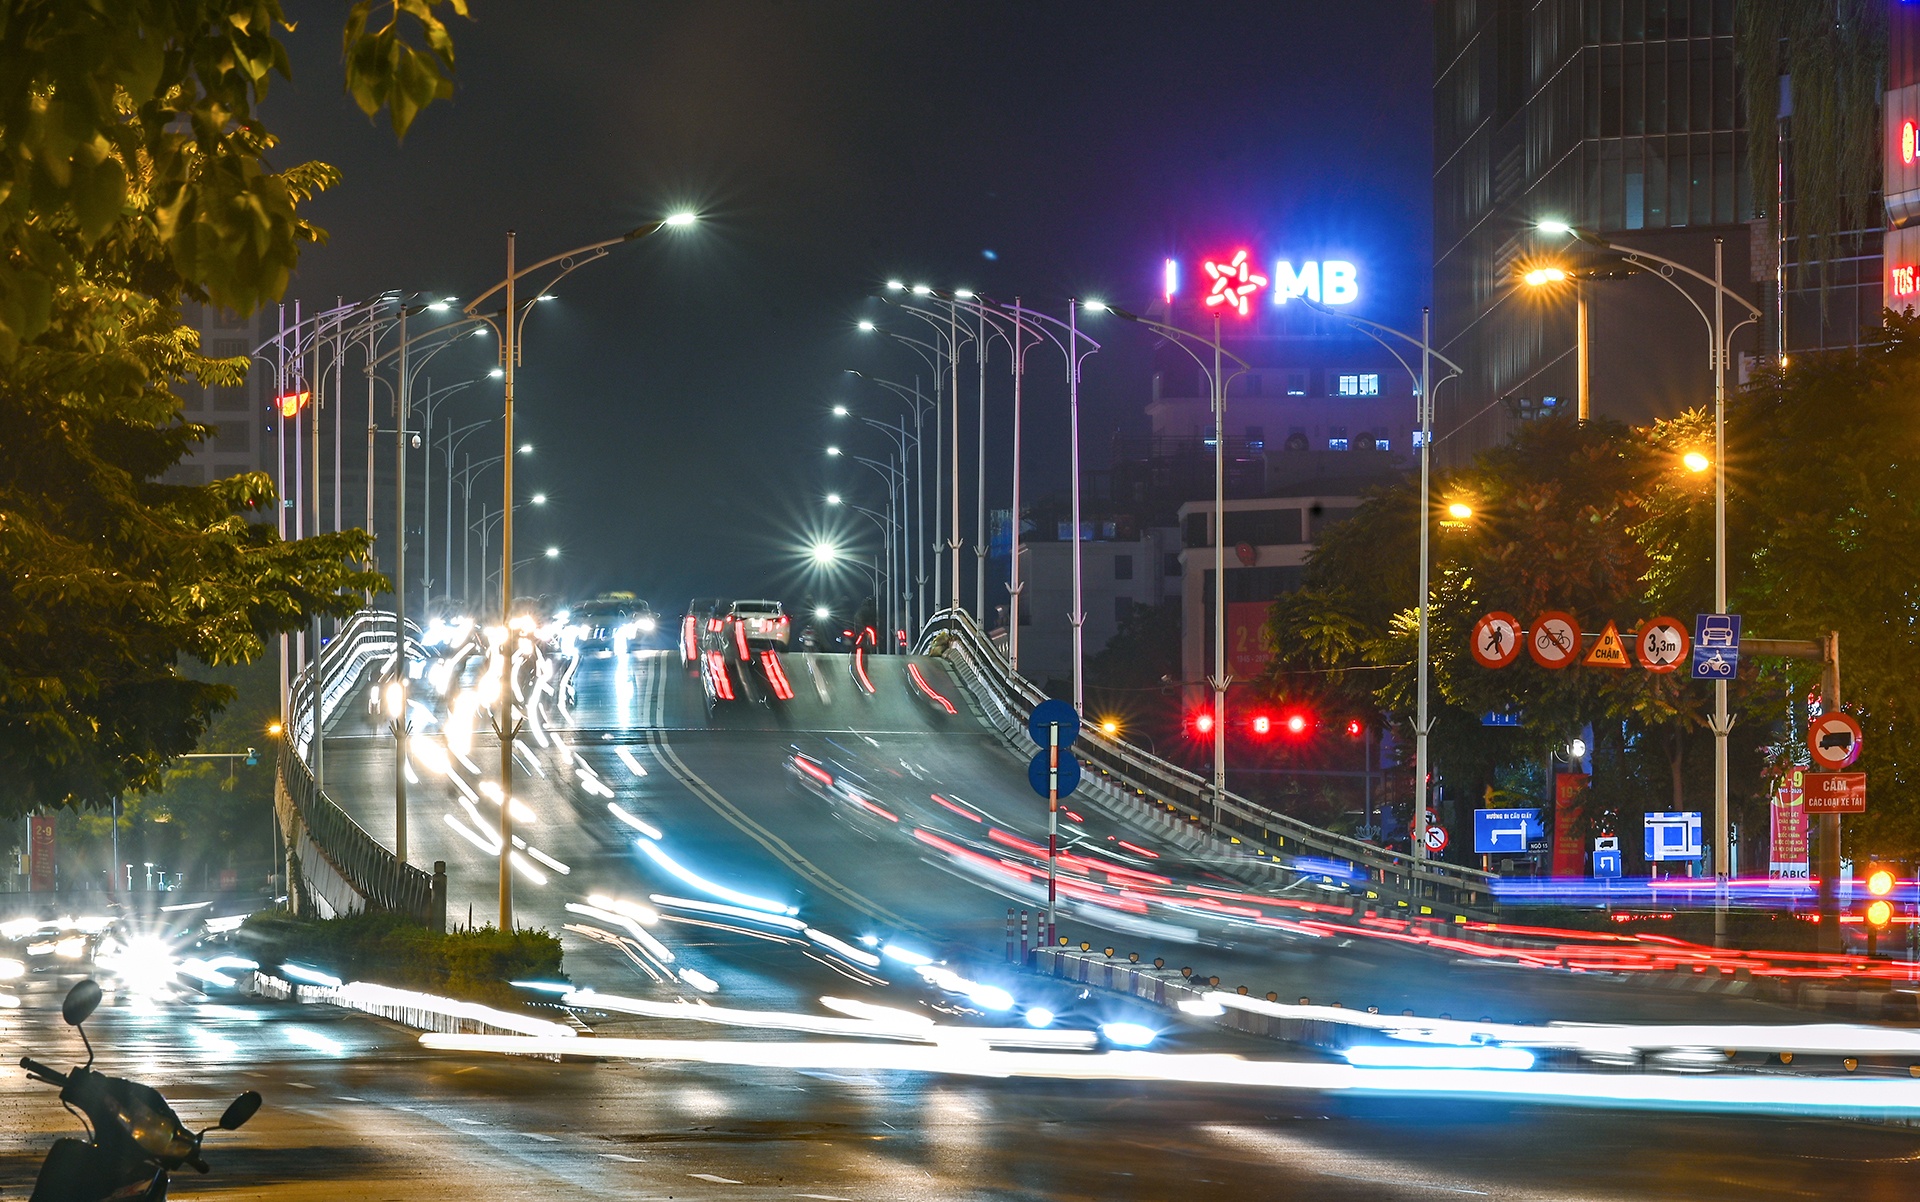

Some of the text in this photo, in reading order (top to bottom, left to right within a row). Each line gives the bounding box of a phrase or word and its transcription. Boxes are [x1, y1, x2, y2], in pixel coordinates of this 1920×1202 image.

[1274, 260, 1358, 305] MB
[1595, 647, 1620, 661] CHẬM
[1823, 777, 1847, 791] CẤM
[1808, 796, 1823, 807] CÁC
[1823, 797, 1839, 808] LOẠI
[1840, 797, 1850, 806] XE
[1781, 869, 1808, 879] ABIC
